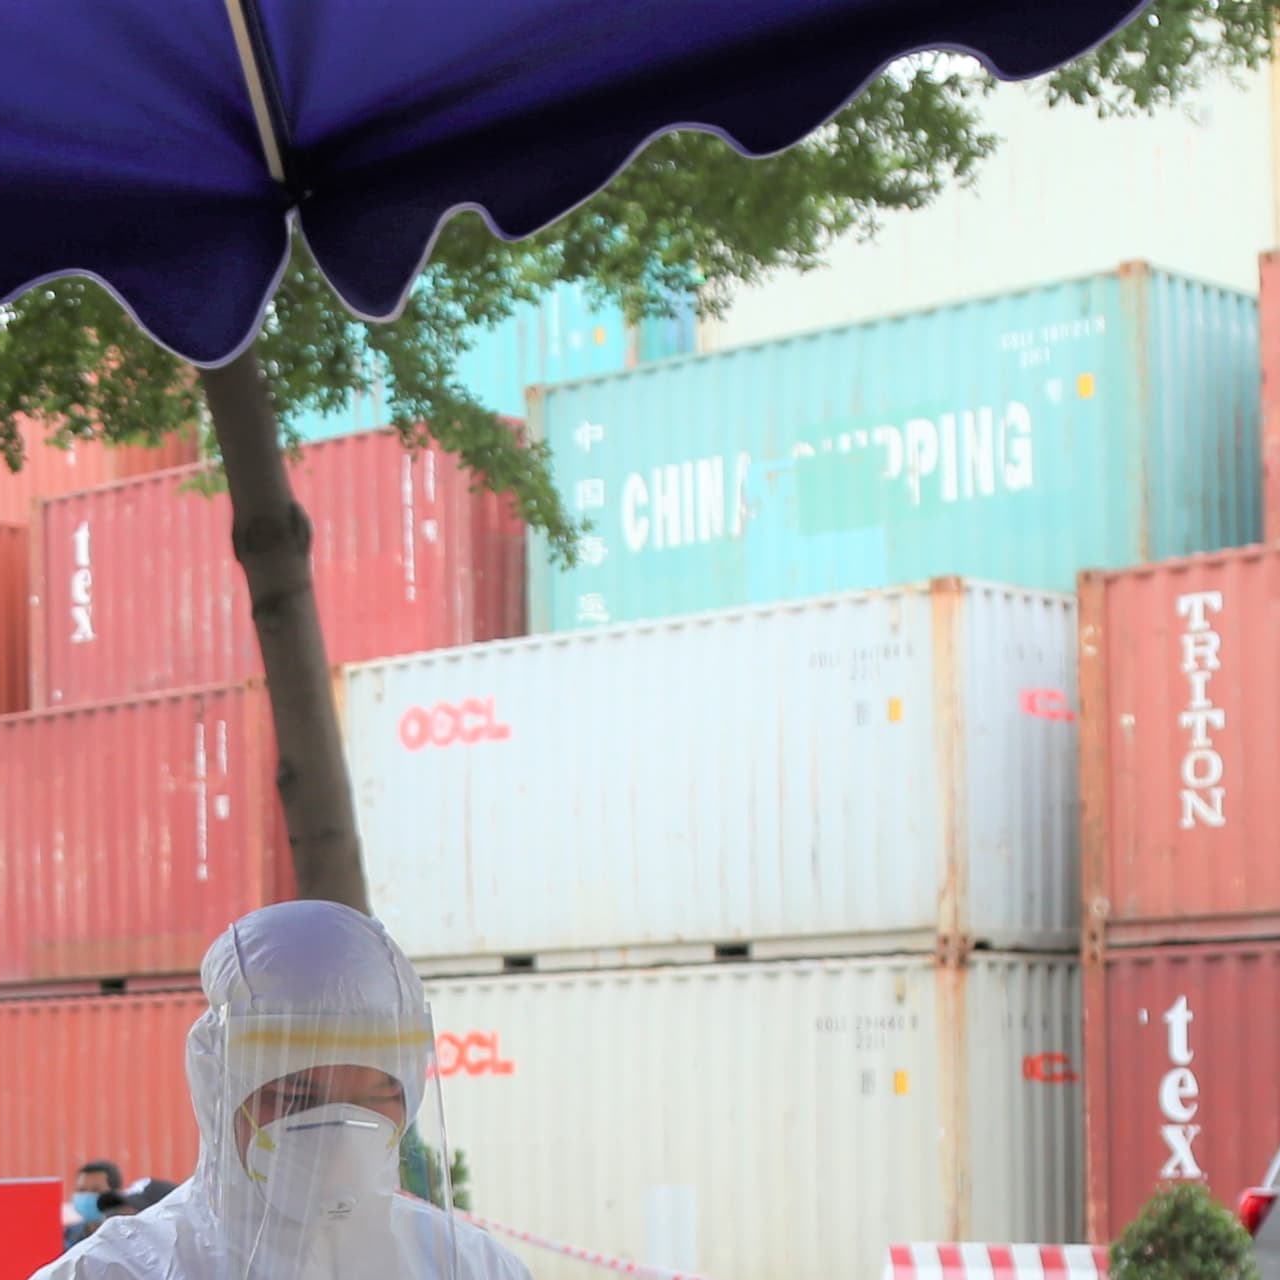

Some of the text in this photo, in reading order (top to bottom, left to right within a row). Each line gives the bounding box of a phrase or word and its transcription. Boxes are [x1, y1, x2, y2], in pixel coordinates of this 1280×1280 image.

[398, 696, 512, 752] OOCL
[1176, 590, 1227, 830] TRITON
[1158, 994, 1203, 1179] tex
